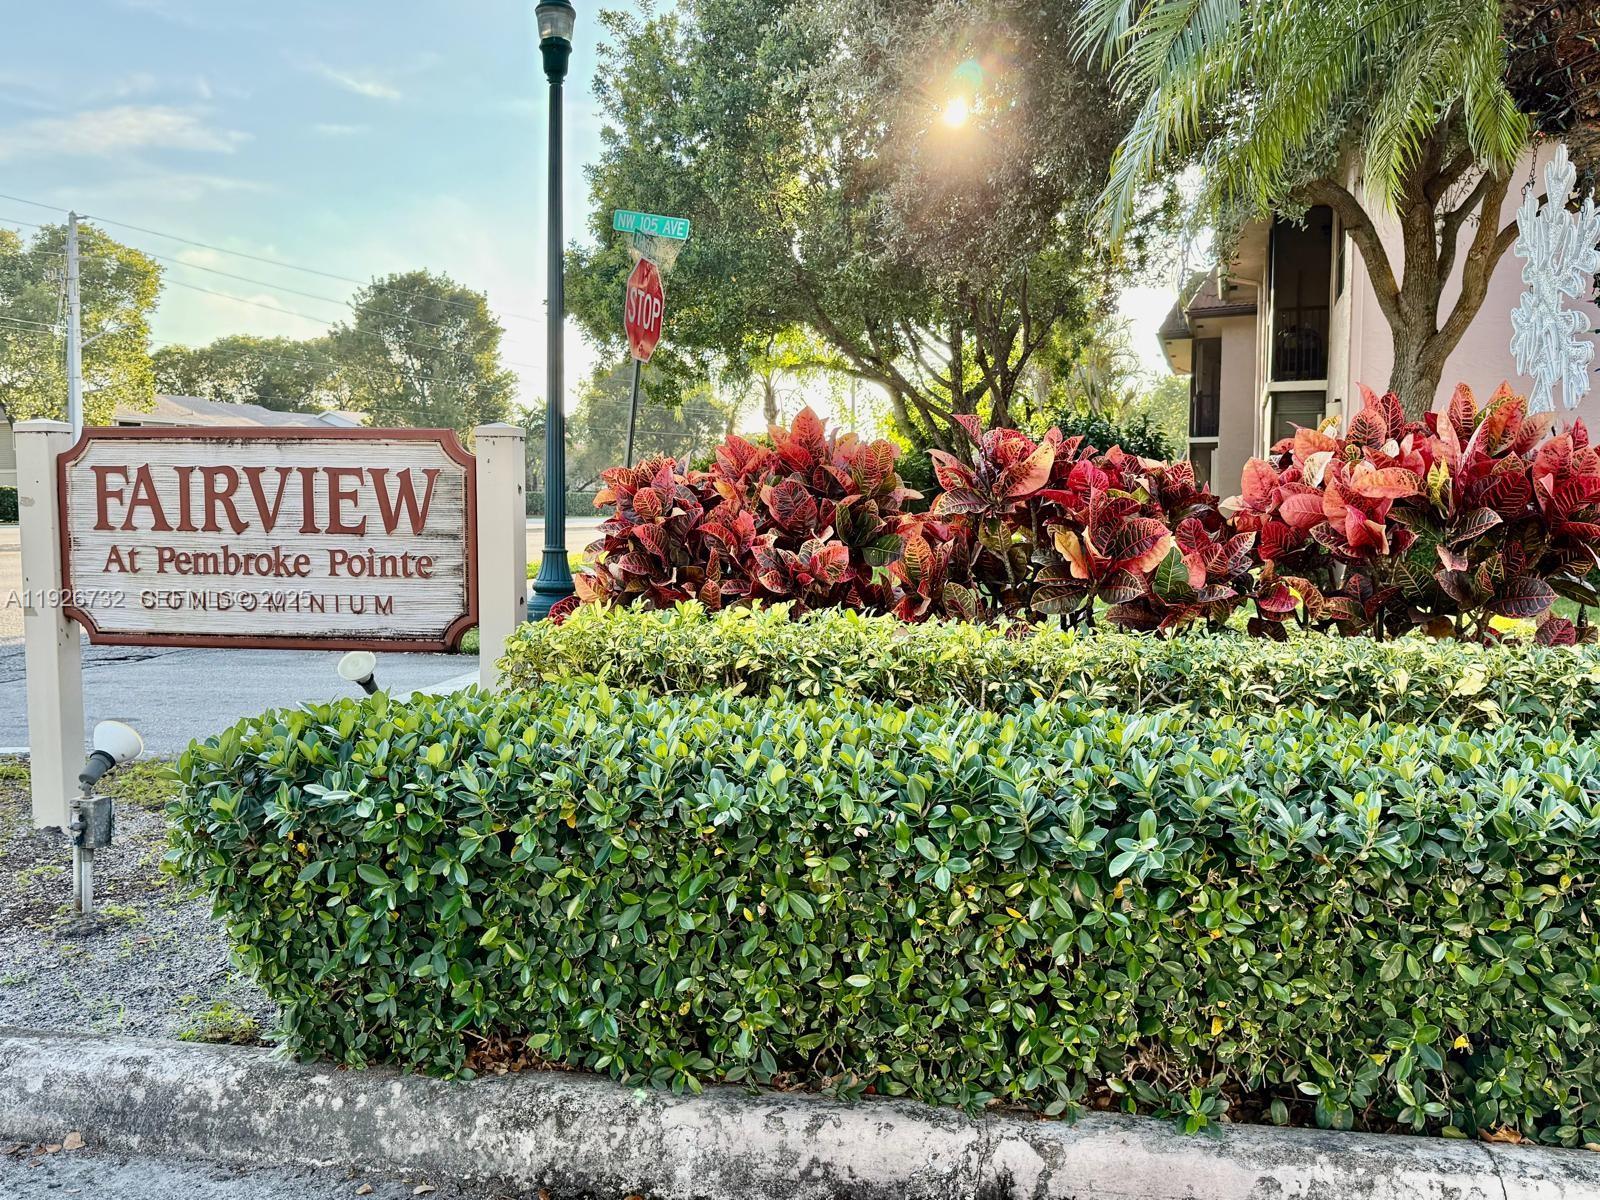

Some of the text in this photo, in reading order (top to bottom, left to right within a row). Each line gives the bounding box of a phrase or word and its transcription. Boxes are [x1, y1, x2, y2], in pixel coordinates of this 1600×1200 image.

[618, 213, 685, 236] NW 105 AVE
[627, 287, 661, 332] STOP
[90, 463, 441, 536] FAIRVIEW
[102, 545, 434, 579] At Pembroke Pointe
[141, 590, 395, 615] CONDOMINIUM
